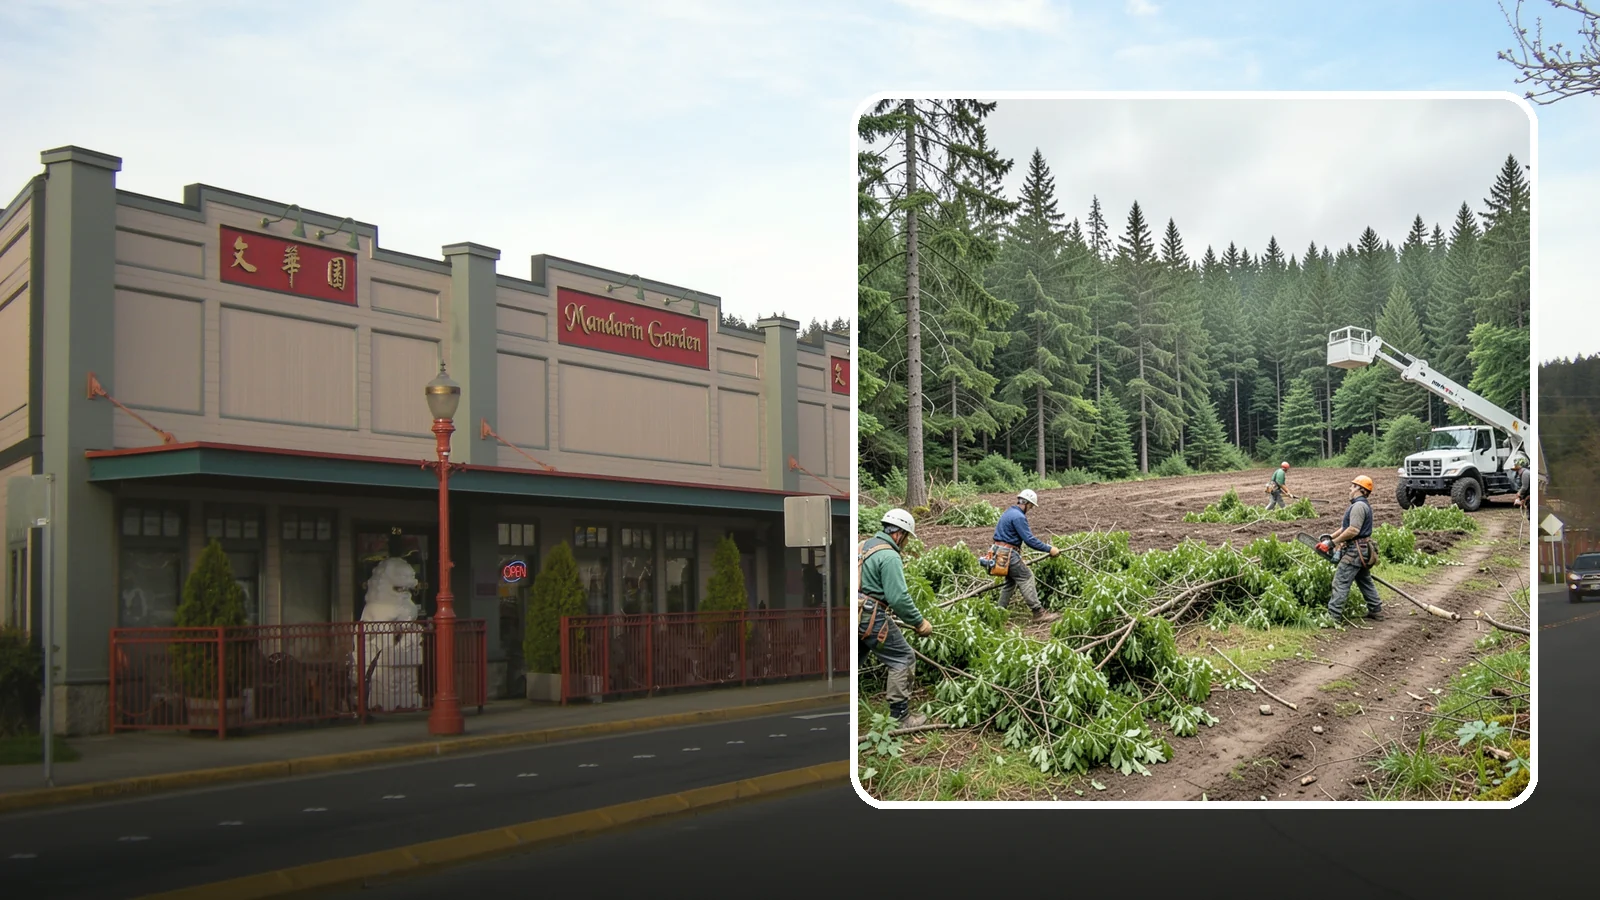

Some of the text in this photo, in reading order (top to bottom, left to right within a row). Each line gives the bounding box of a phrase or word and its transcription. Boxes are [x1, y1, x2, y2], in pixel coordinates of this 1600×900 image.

[564, 302, 701, 352] Mandarin Garden
[503, 565, 527, 578] OPEN
